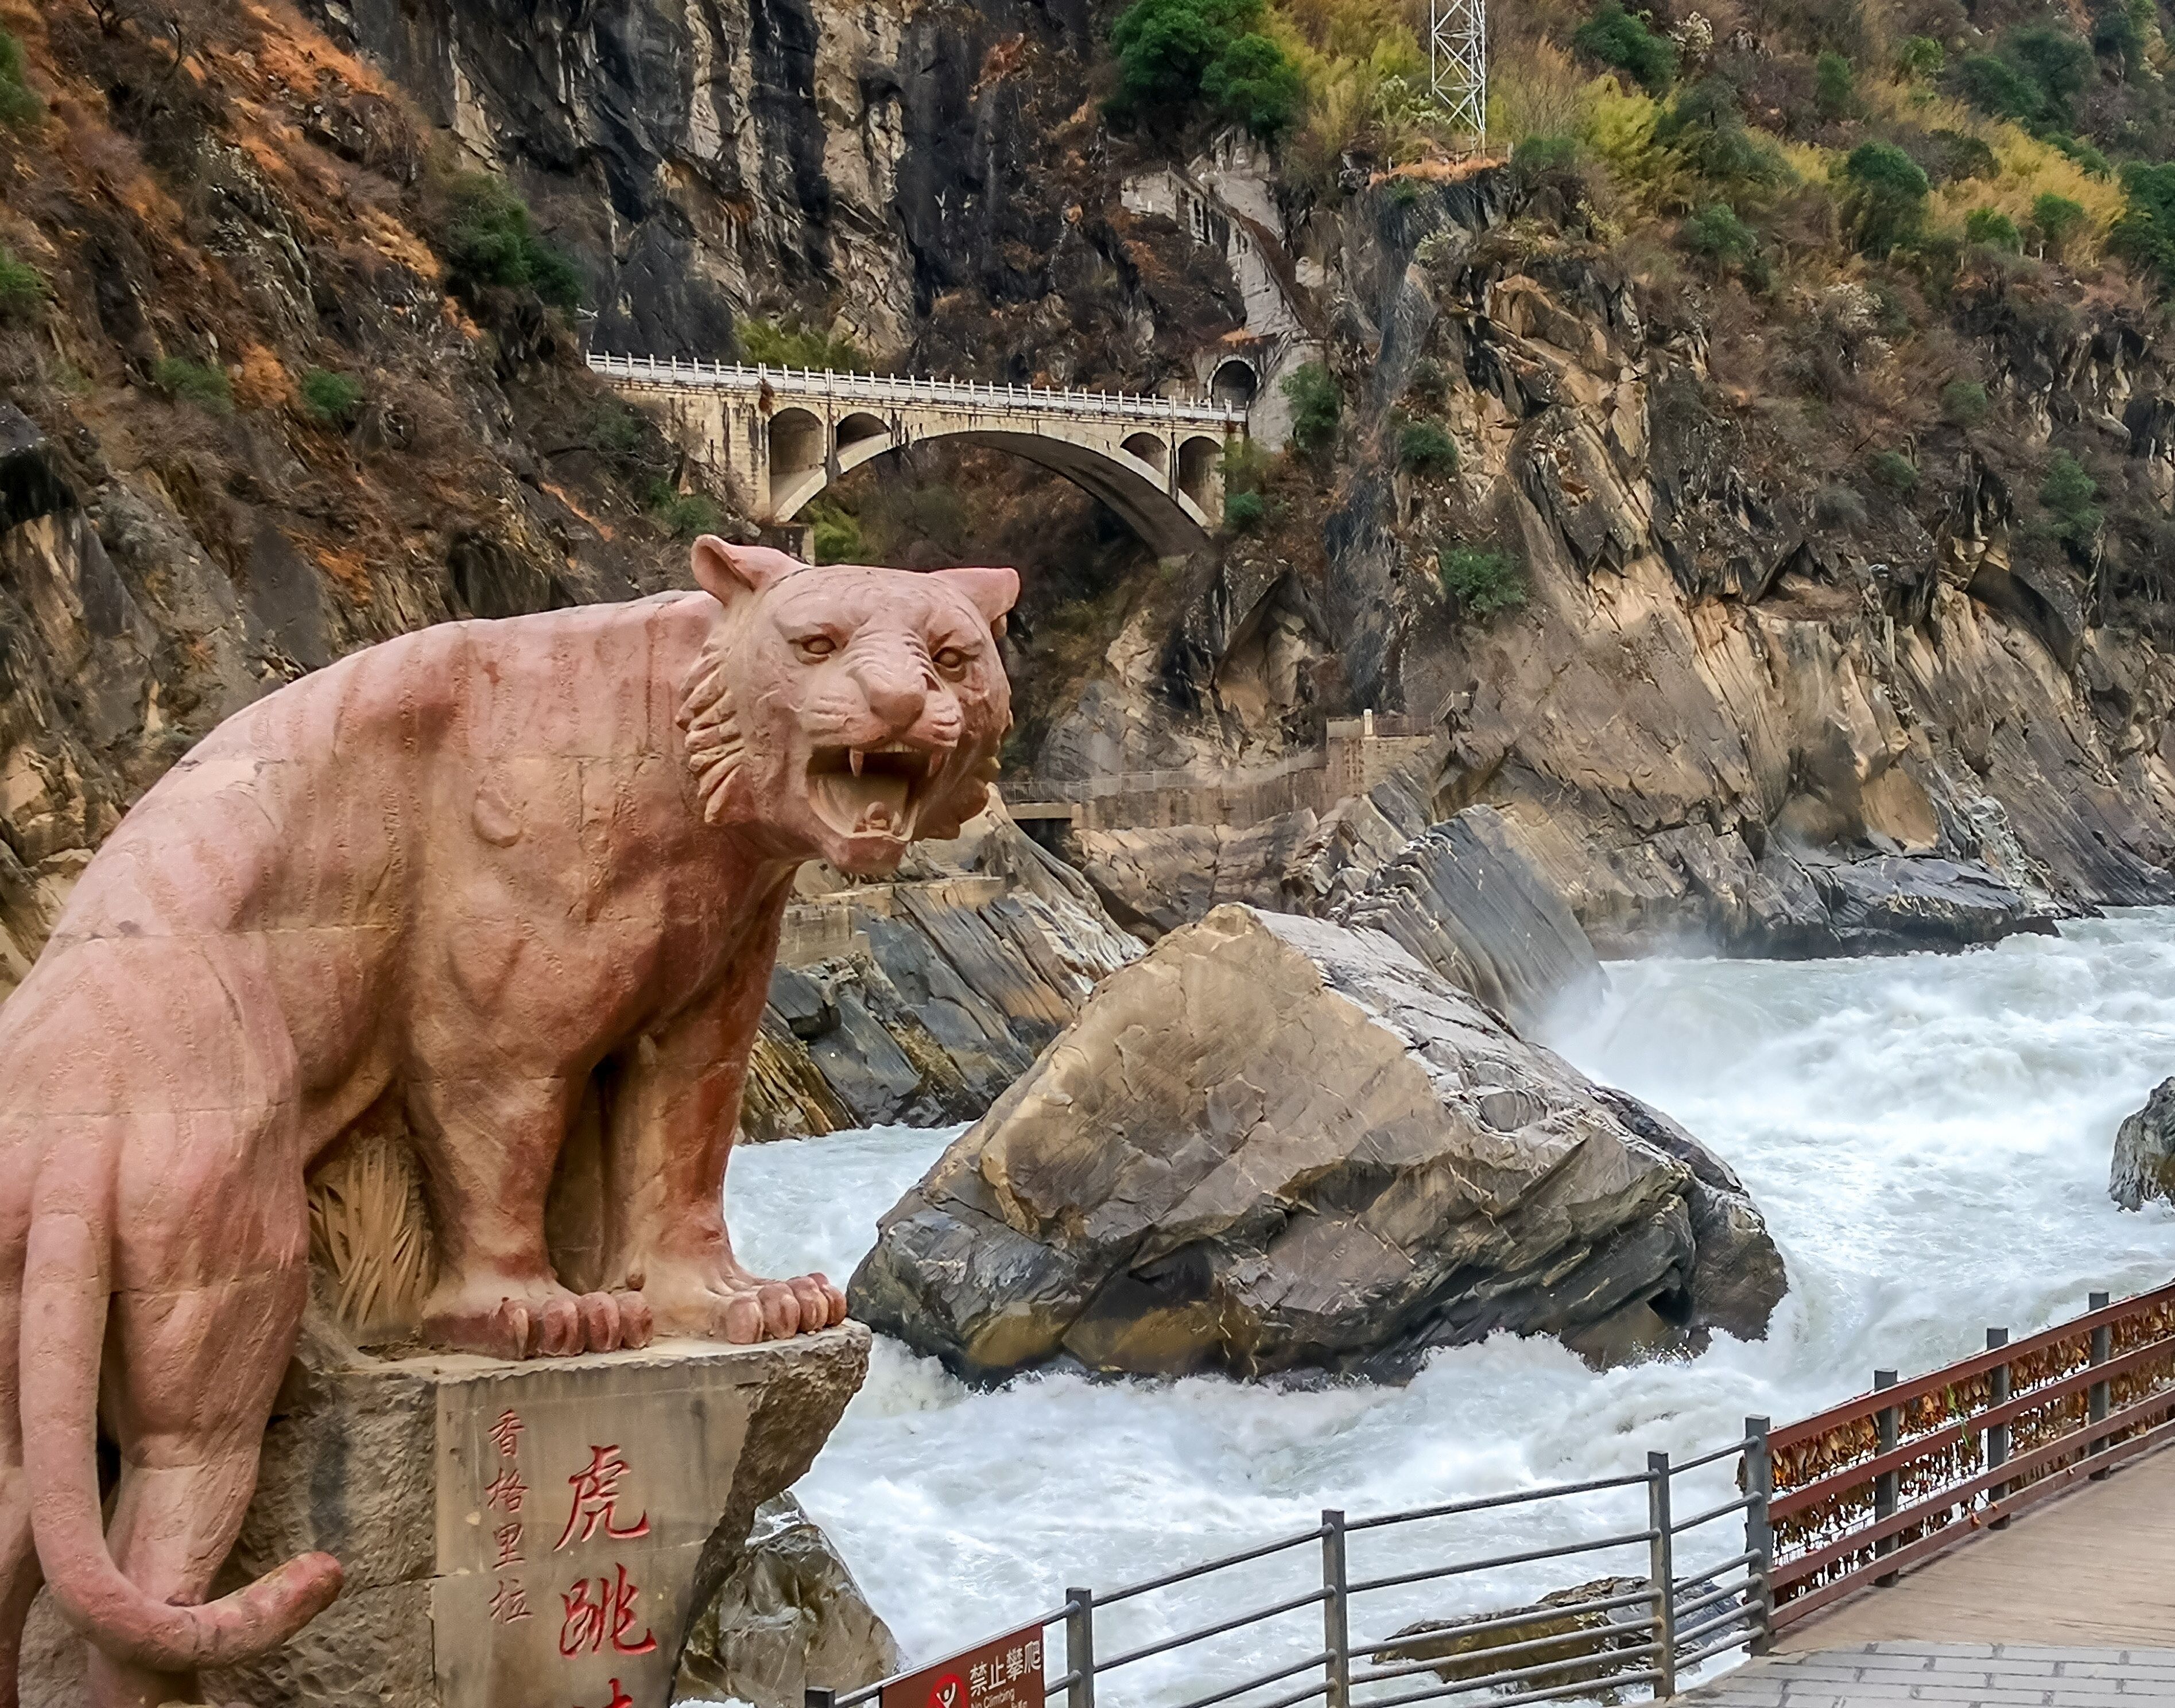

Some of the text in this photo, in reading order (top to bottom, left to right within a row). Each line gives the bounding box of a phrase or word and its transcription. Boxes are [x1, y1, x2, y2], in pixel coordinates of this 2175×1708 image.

[485, 1409, 533, 1625] 香格里拉
[553, 1445, 657, 1708] 虎跳
[970, 1640, 1041, 1697] 禁止攀爬
